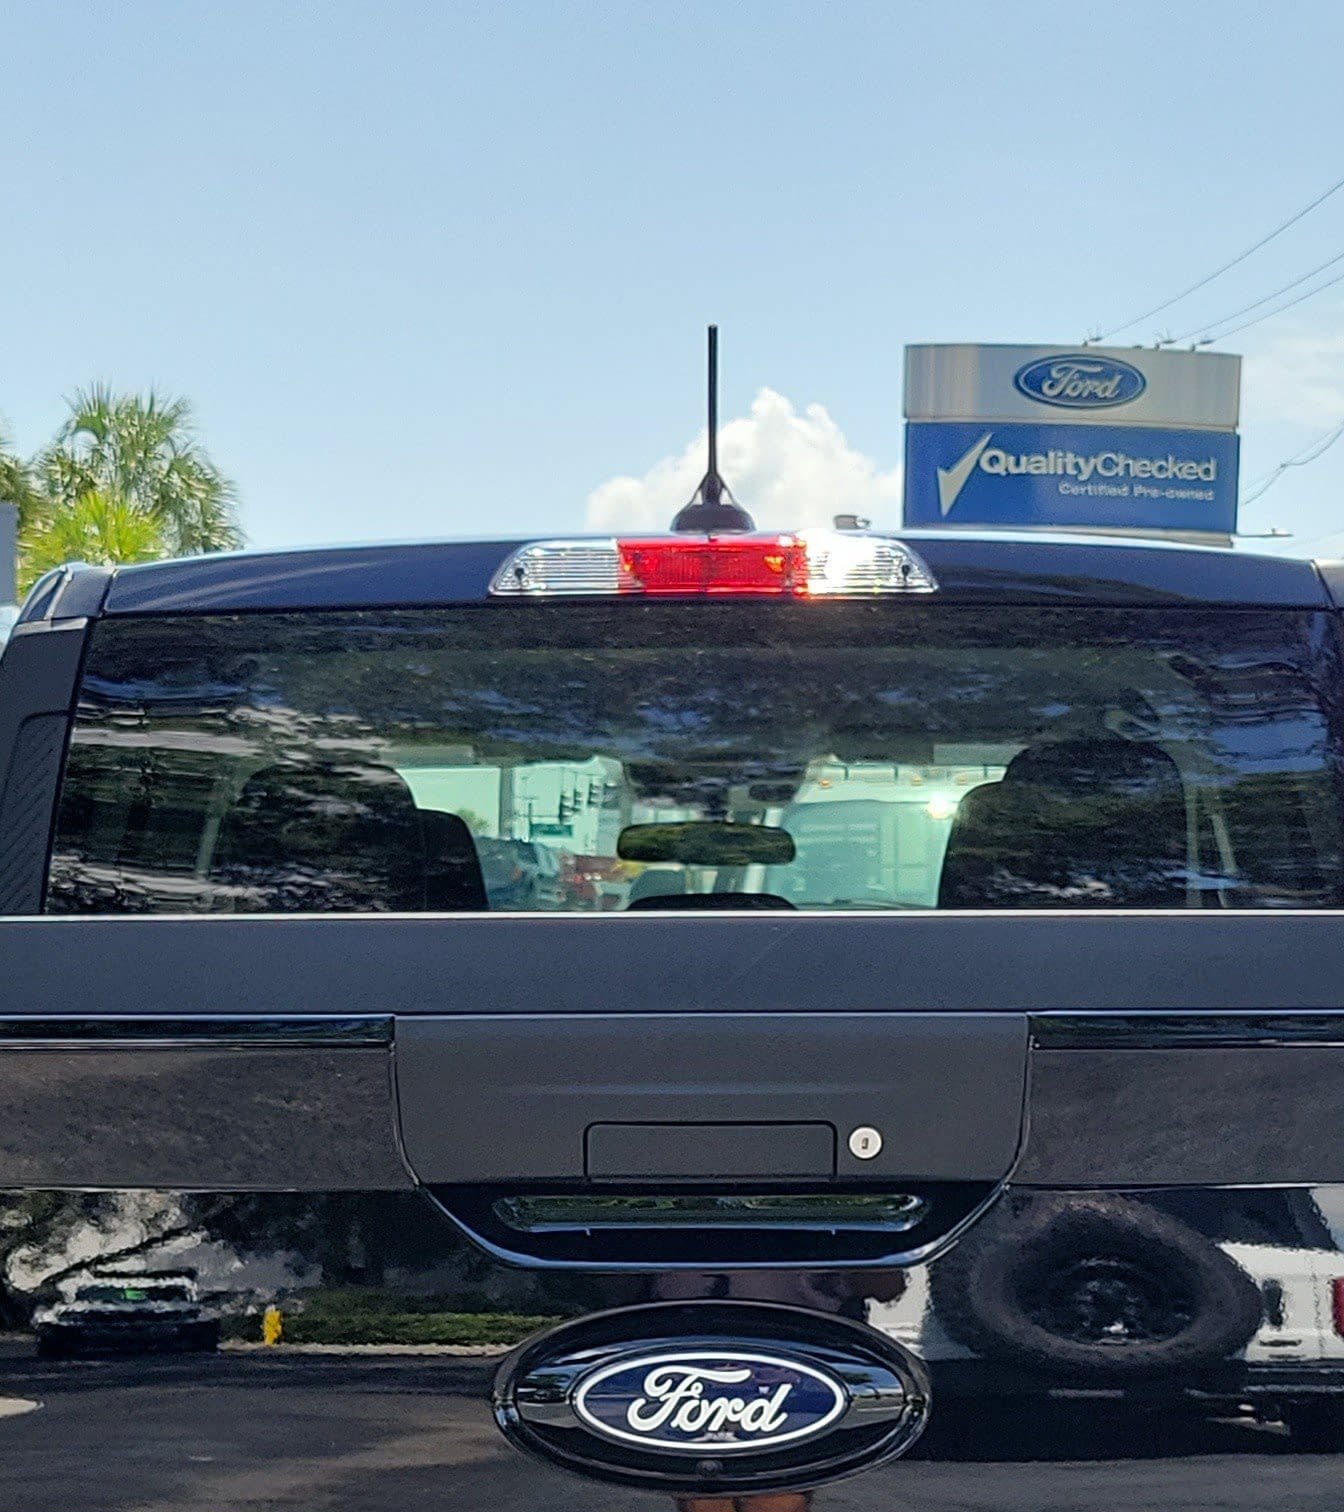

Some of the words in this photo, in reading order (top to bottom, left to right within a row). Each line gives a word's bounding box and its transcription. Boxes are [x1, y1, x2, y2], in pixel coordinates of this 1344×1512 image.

[1041, 363, 1121, 400] Ford
[1058, 481, 1129, 498] Certified
[1133, 484, 1215, 501] Pre-owned
[626, 1363, 792, 1433] Ford
